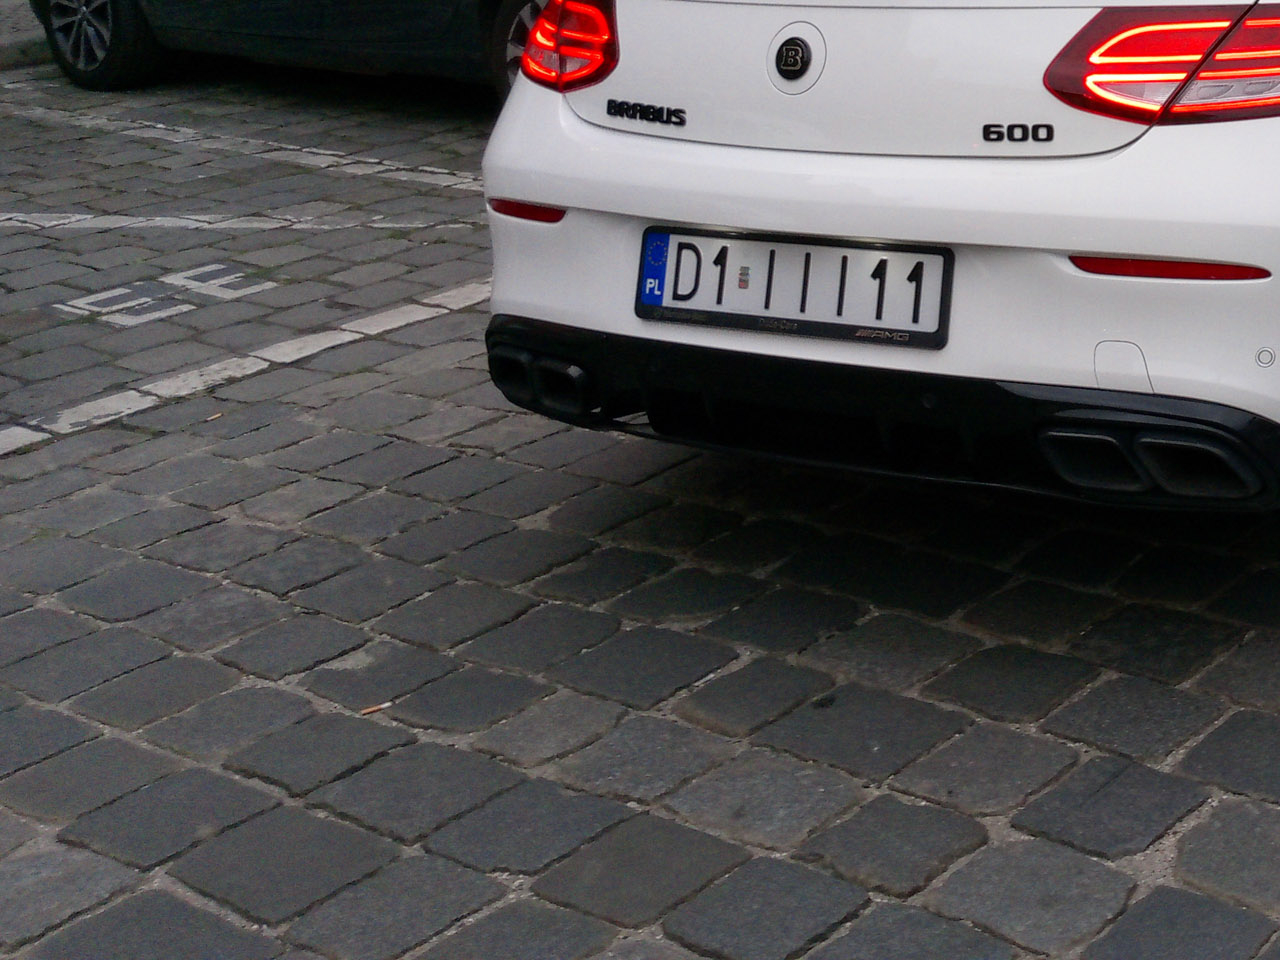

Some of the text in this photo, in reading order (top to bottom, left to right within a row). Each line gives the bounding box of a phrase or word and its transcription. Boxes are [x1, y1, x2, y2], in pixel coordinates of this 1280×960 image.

[606, 98, 687, 127] BRABUS
[982, 123, 1055, 143] 600
[646, 278, 662, 296] PL
